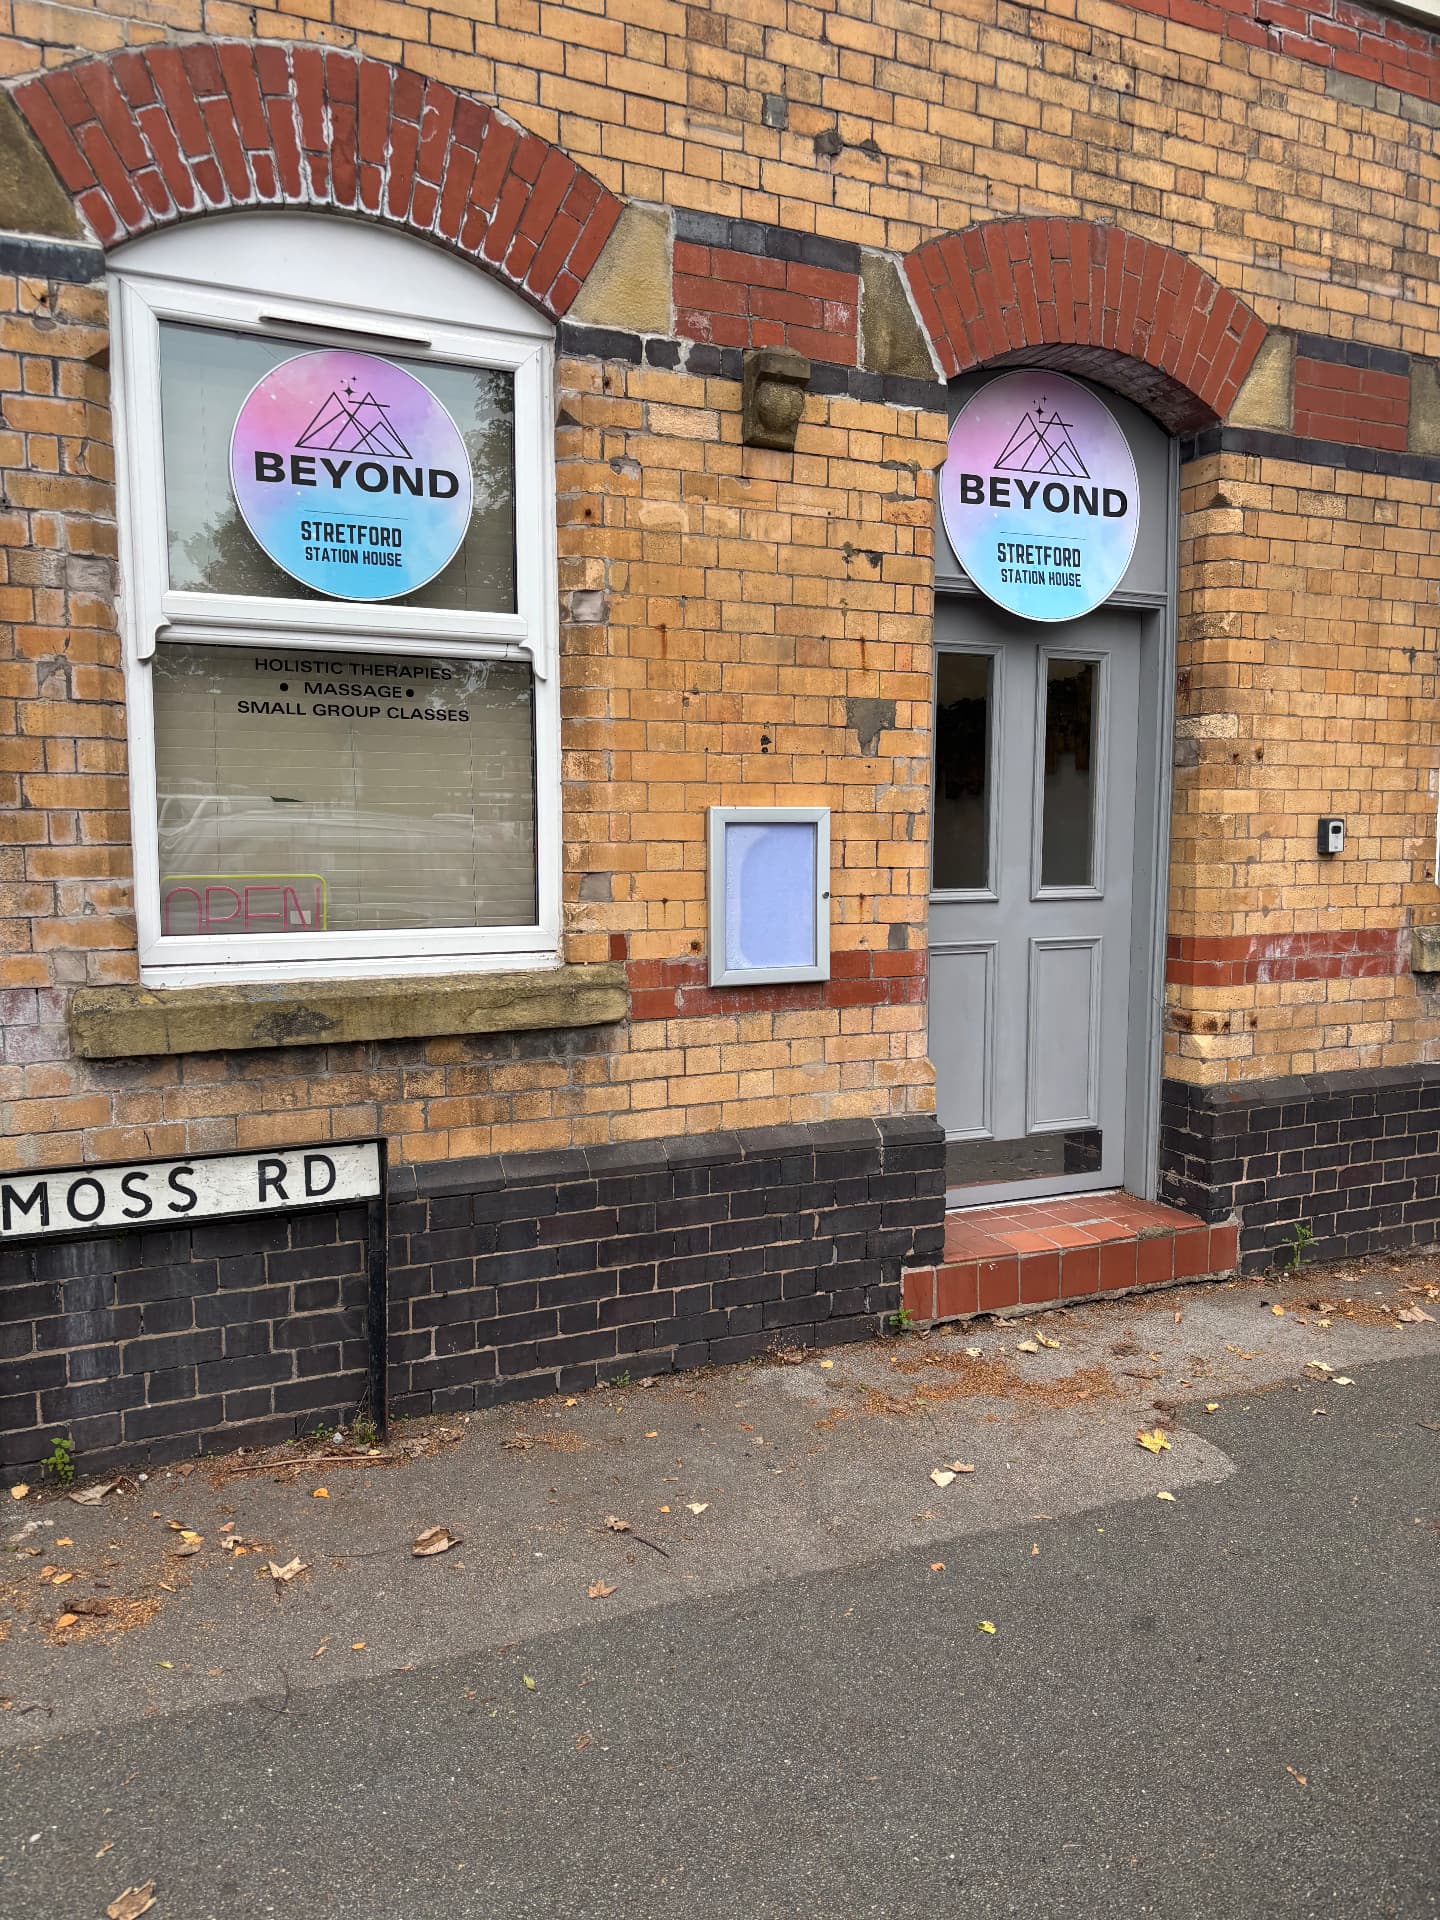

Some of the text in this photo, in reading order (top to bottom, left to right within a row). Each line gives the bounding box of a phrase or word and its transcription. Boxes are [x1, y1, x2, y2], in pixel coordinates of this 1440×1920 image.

[254, 451, 459, 499] BEYOND
[960, 474, 1128, 518] BEYOND
[301, 520, 402, 548] STRETFORD
[305, 546, 402, 567] STATION HOUSE
[997, 542, 1081, 568] STRETFORD
[1001, 568, 1082, 588] STATION HOUSE
[255, 658, 452, 681] HOLISTIC THERAPIES
[304, 682, 402, 698] MASSAGE
[237, 700, 470, 722] SMALL GROUP CLASSES
[164, 885, 322, 935] OPEN
[1, 1154, 337, 1230] MOSS RD
